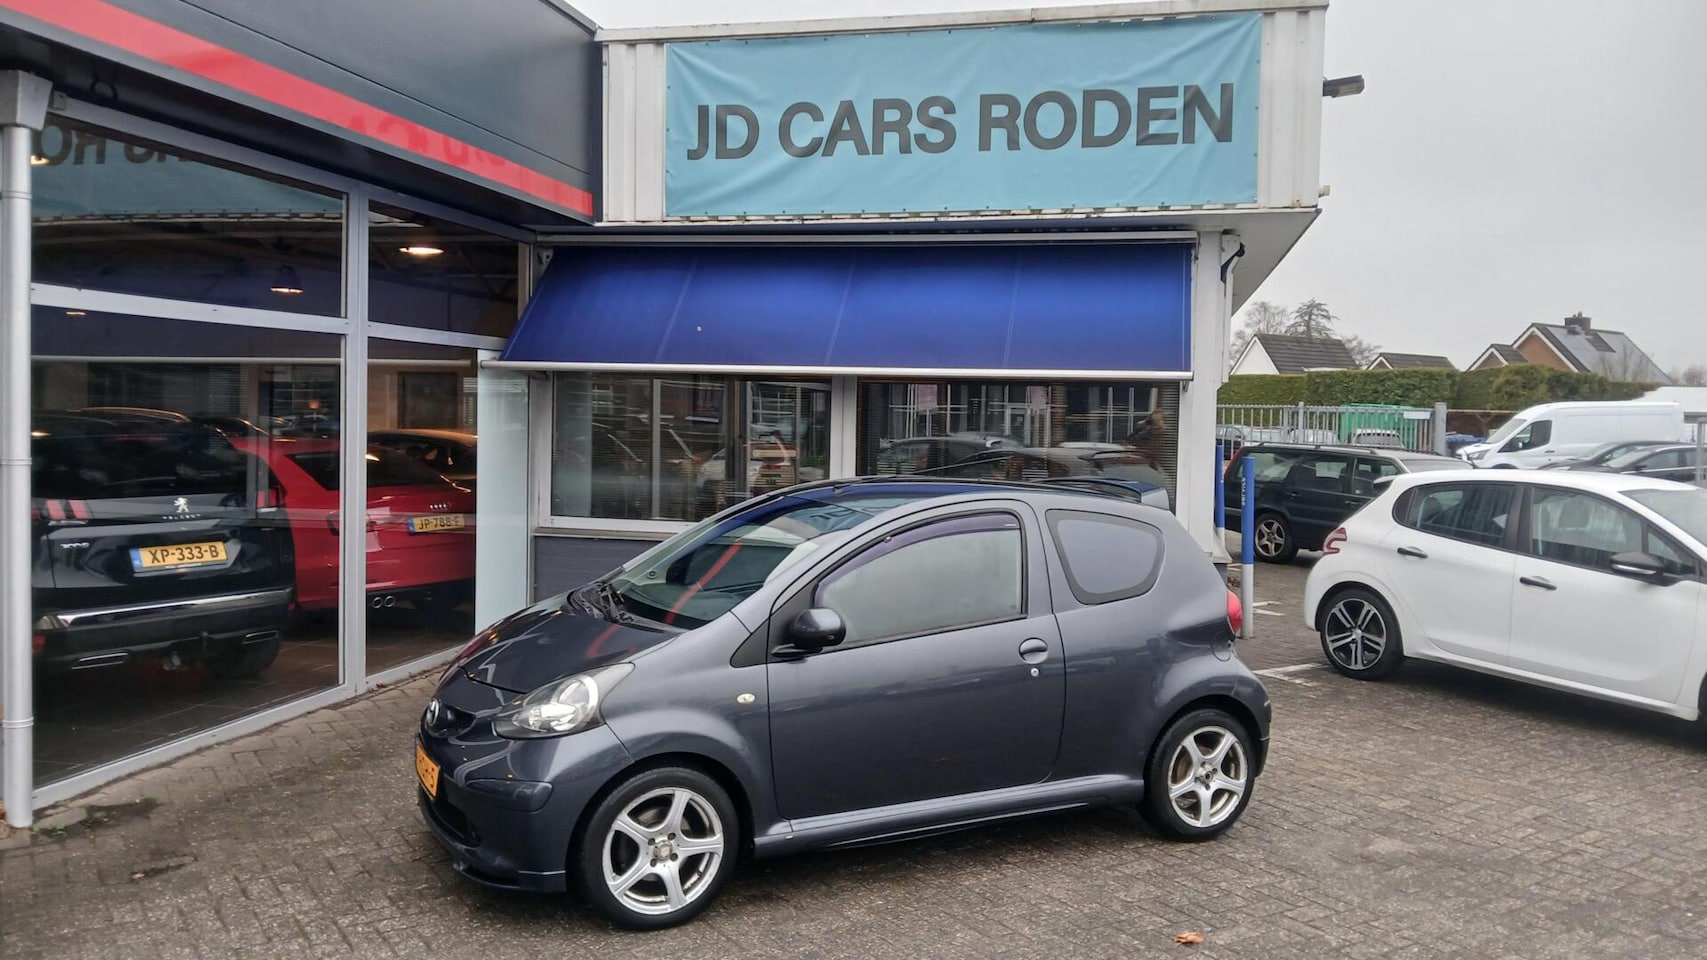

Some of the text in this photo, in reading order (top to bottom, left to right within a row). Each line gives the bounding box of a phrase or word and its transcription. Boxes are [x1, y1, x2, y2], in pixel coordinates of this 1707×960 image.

[687, 83, 1234, 160] JD CARS RODEN
[149, 544, 219, 564] XP-333-B
